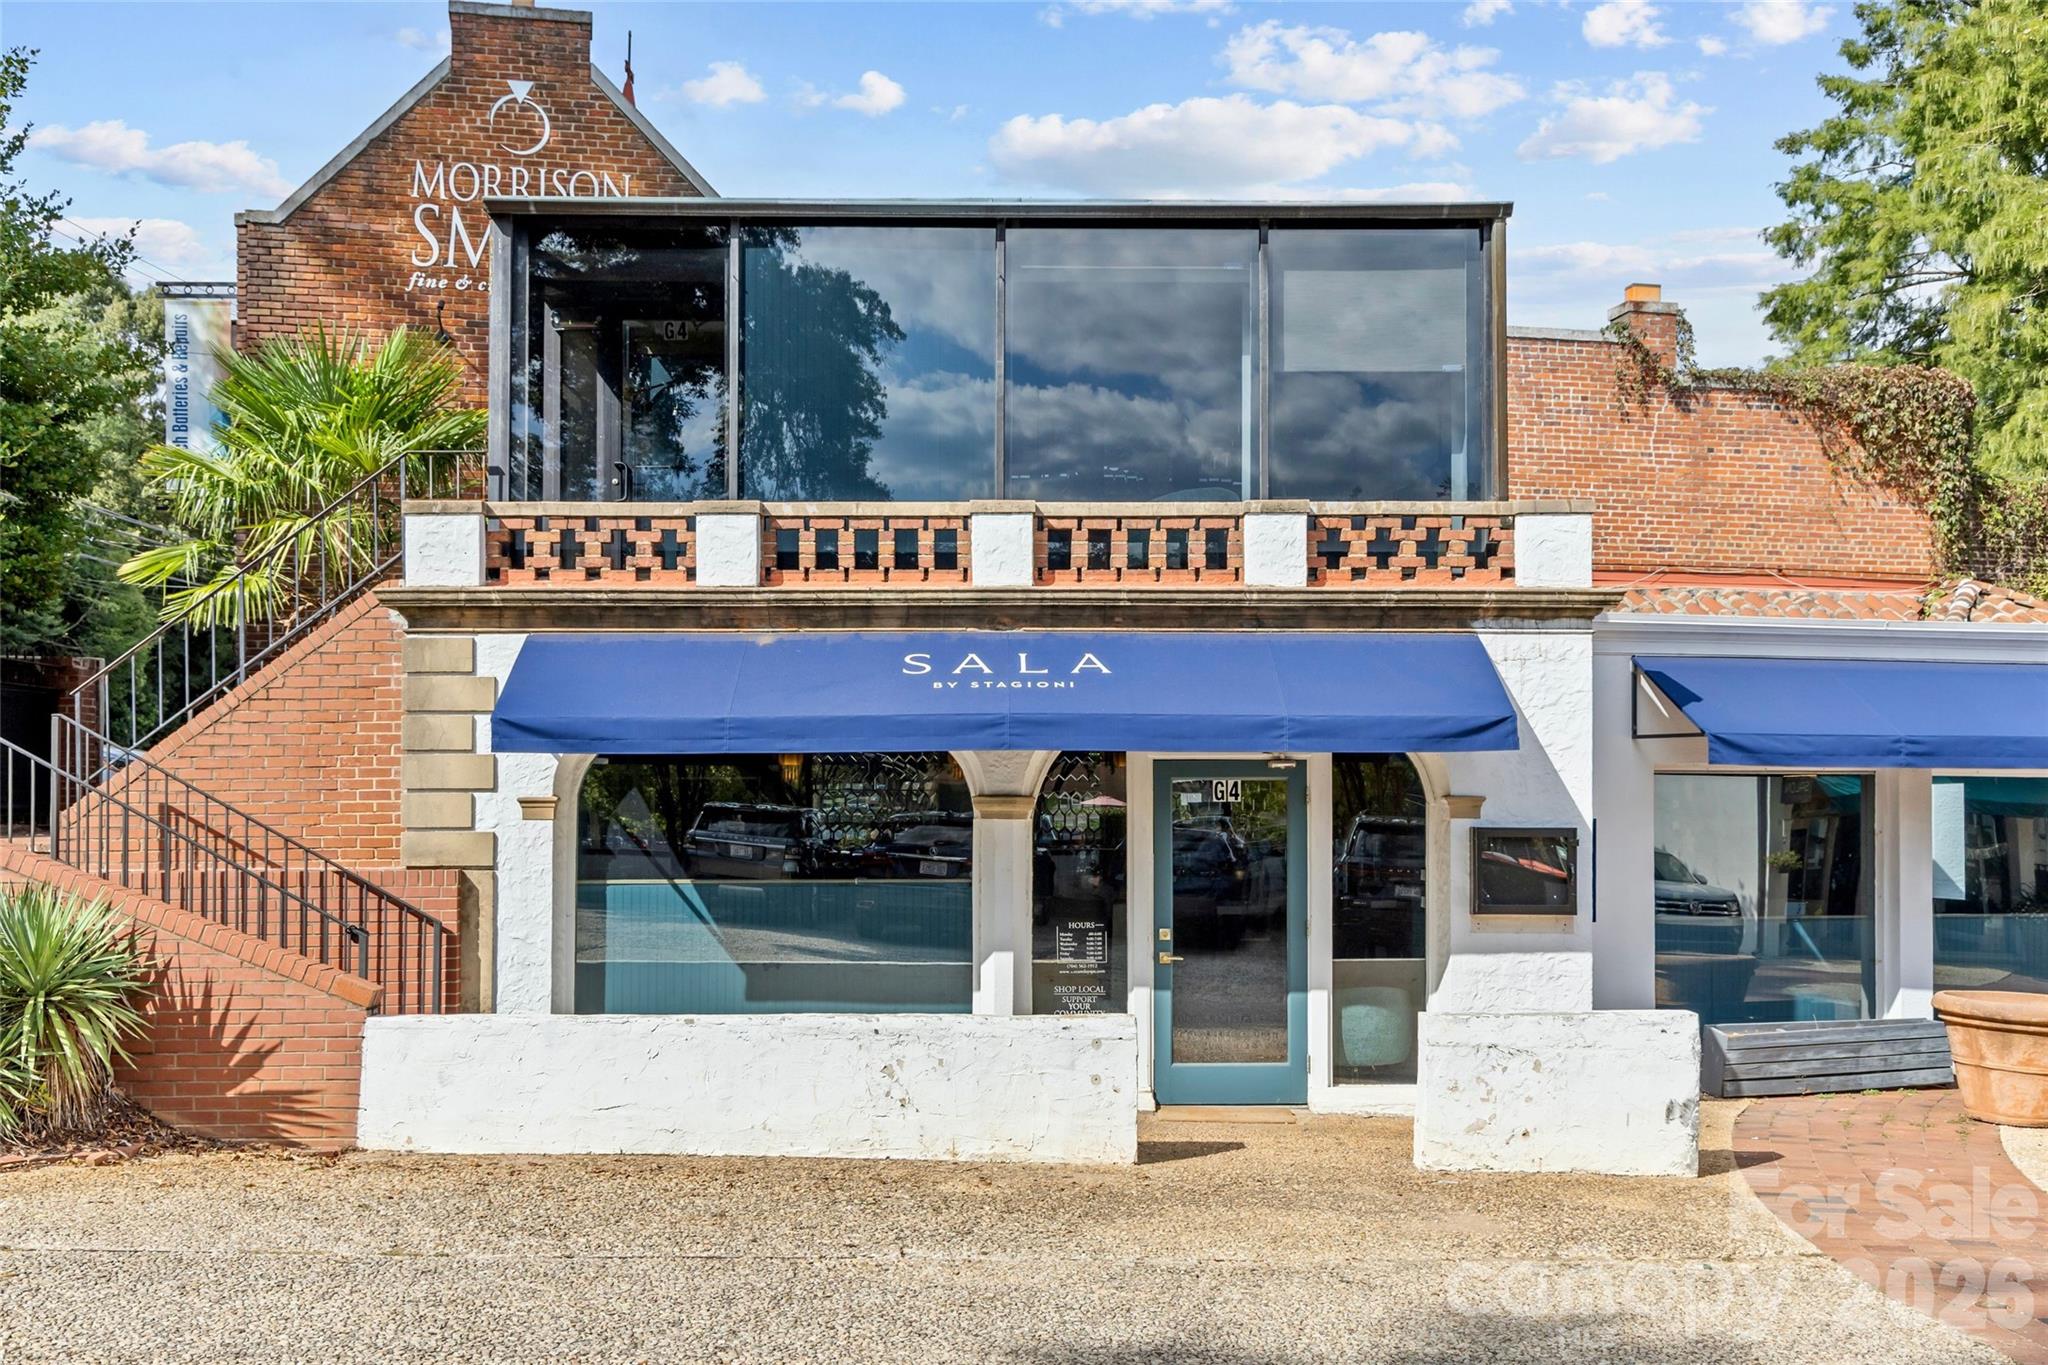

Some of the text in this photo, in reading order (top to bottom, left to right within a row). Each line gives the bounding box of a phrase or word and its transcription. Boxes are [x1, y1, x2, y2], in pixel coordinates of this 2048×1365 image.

[410, 159, 631, 201] MORRISON
[405, 272, 448, 291] fine
[455, 275, 472, 291] &
[172, 313, 190, 360] Repairs
[172, 362, 188, 372] &
[172, 377, 189, 433] Batteries
[902, 652, 1113, 675] SALA
[933, 681, 1075, 689] BY STAGIONI
[1068, 921, 1096, 929] HOURS
[1054, 985, 1106, 993] SHOP LOCAL
[1062, 995, 1098, 1003] SUPPORT
